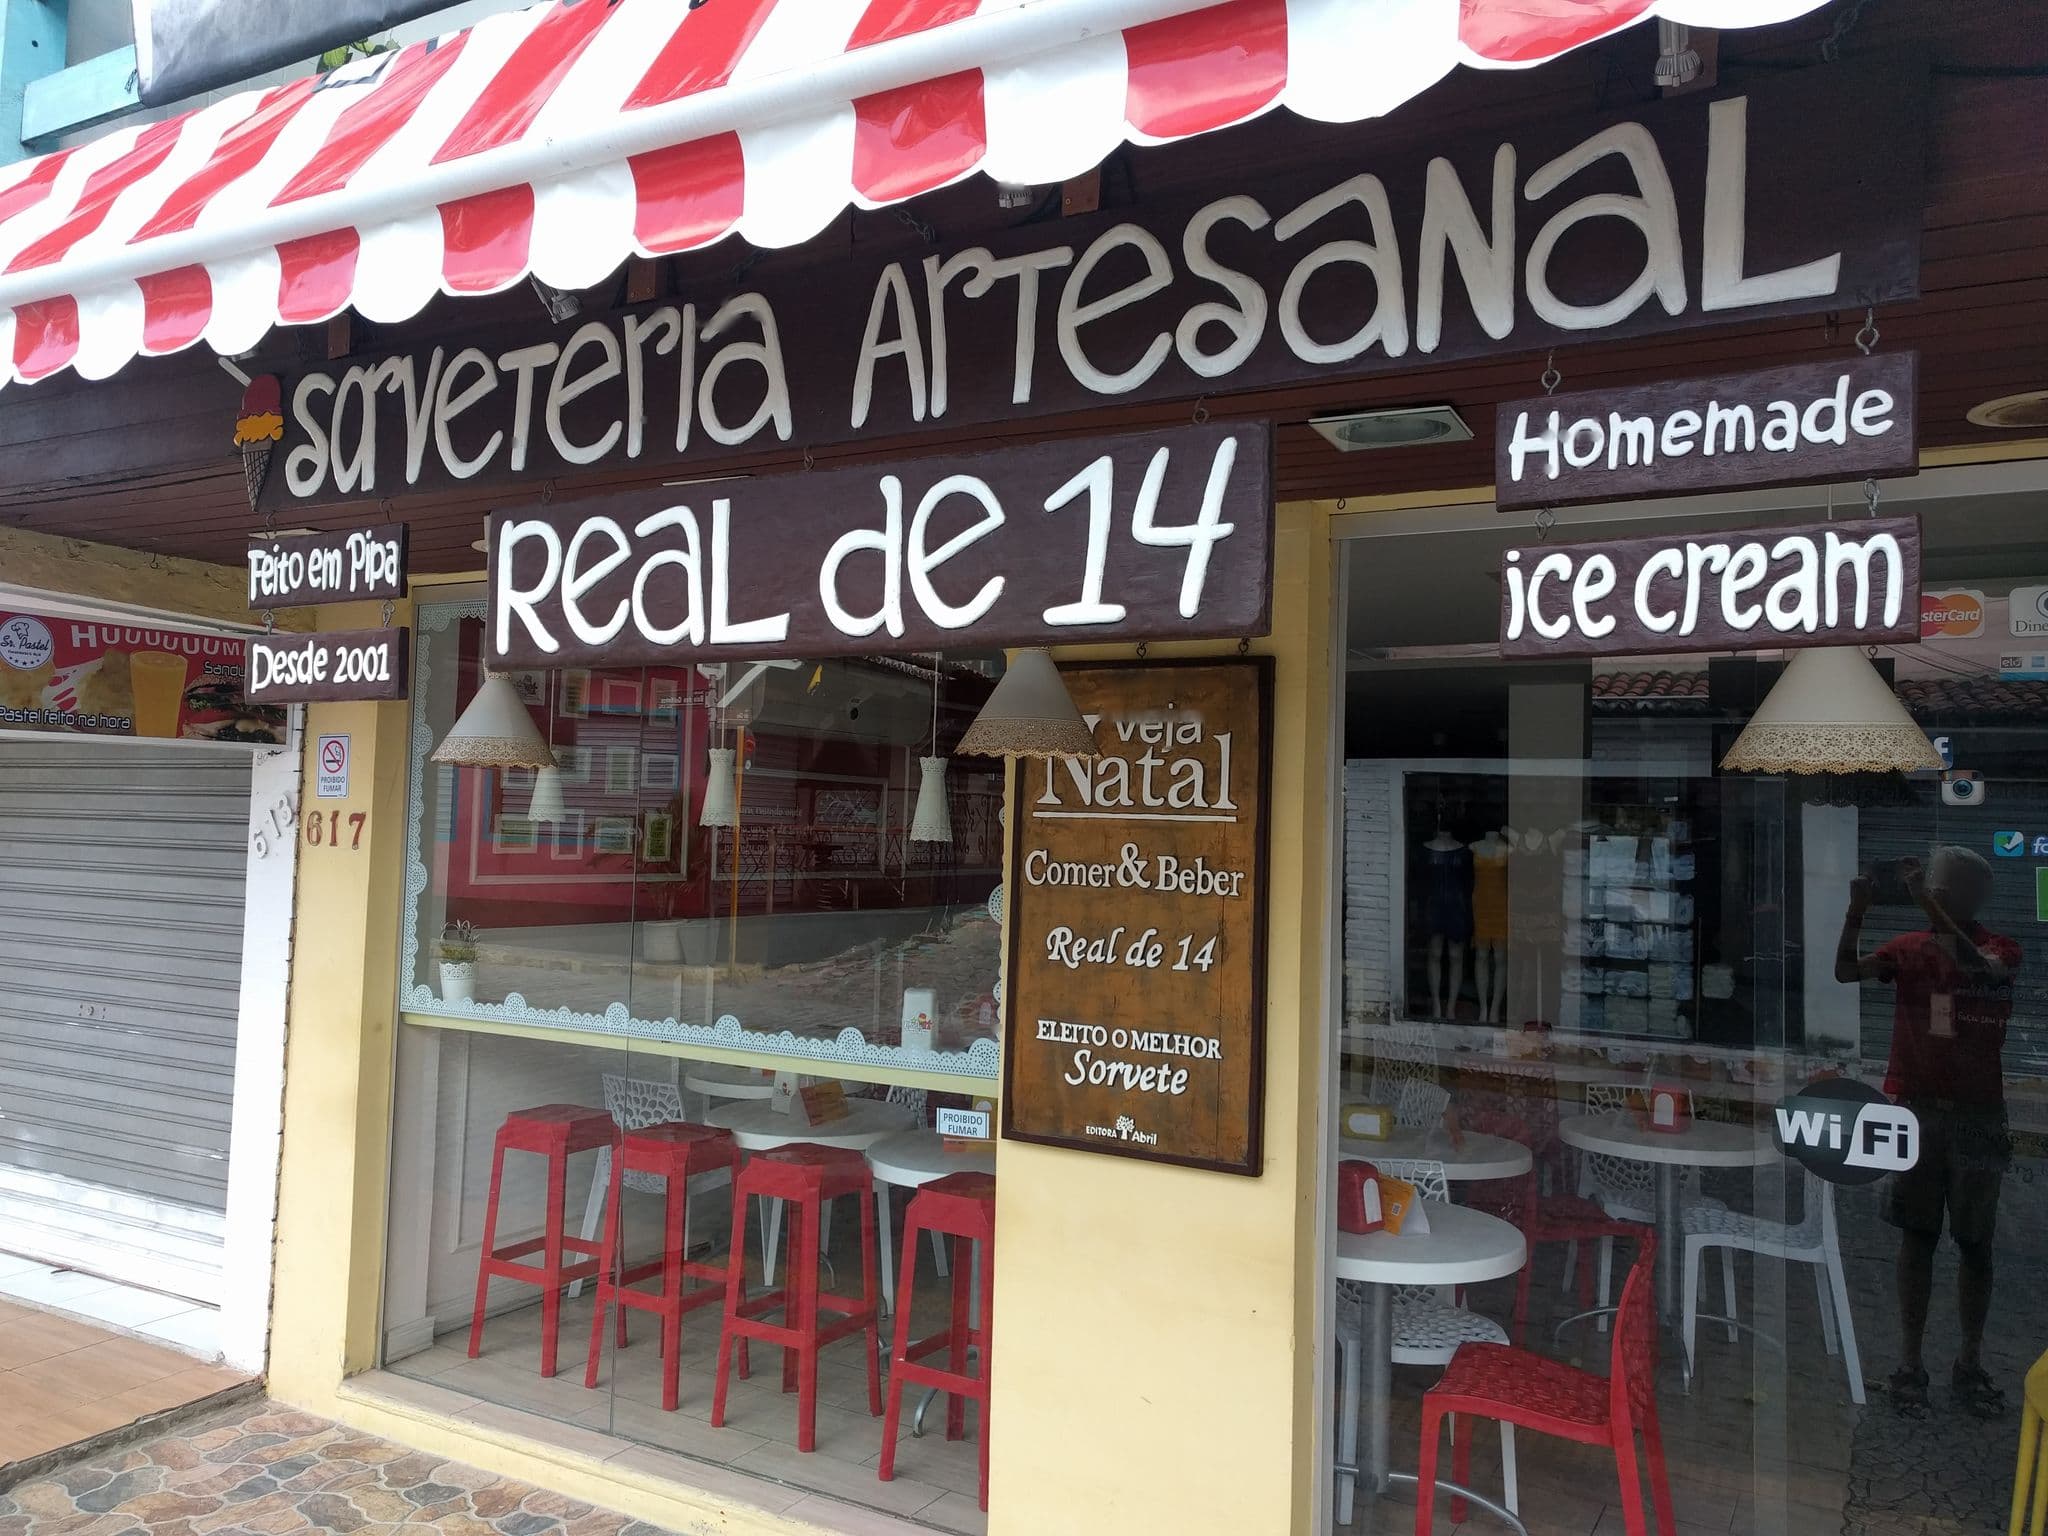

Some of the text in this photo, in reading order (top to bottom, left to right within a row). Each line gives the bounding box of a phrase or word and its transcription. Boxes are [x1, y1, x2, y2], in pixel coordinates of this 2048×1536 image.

[1508, 374, 1894, 482] Homemade
[819, 473, 1006, 639] de
[1042, 436, 1238, 626] 14
[248, 529, 399, 601] Feito em Pipa
[1506, 530, 1903, 641] ice cream
[18, 636, 50, 651] Pastel
[250, 640, 391, 694] Desde 2001
[78, 714, 97, 727] na
[99, 712, 131, 729] hora
[320, 776, 346, 784] PROIBIDO
[323, 784, 342, 792] FUMAR
[306, 809, 367, 851] 617
[1154, 854, 1244, 897] Beber
[1046, 926, 1218, 972] Real de 14
[1036, 1019, 1222, 1060] ELEITO O MELHOR
[1064, 1049, 1189, 1095] Sorvete
[943, 1112, 983, 1126] PROIBIDO
[947, 1124, 978, 1136] FUMAR
[1085, 1125, 1158, 1145] EDITORA Abril
